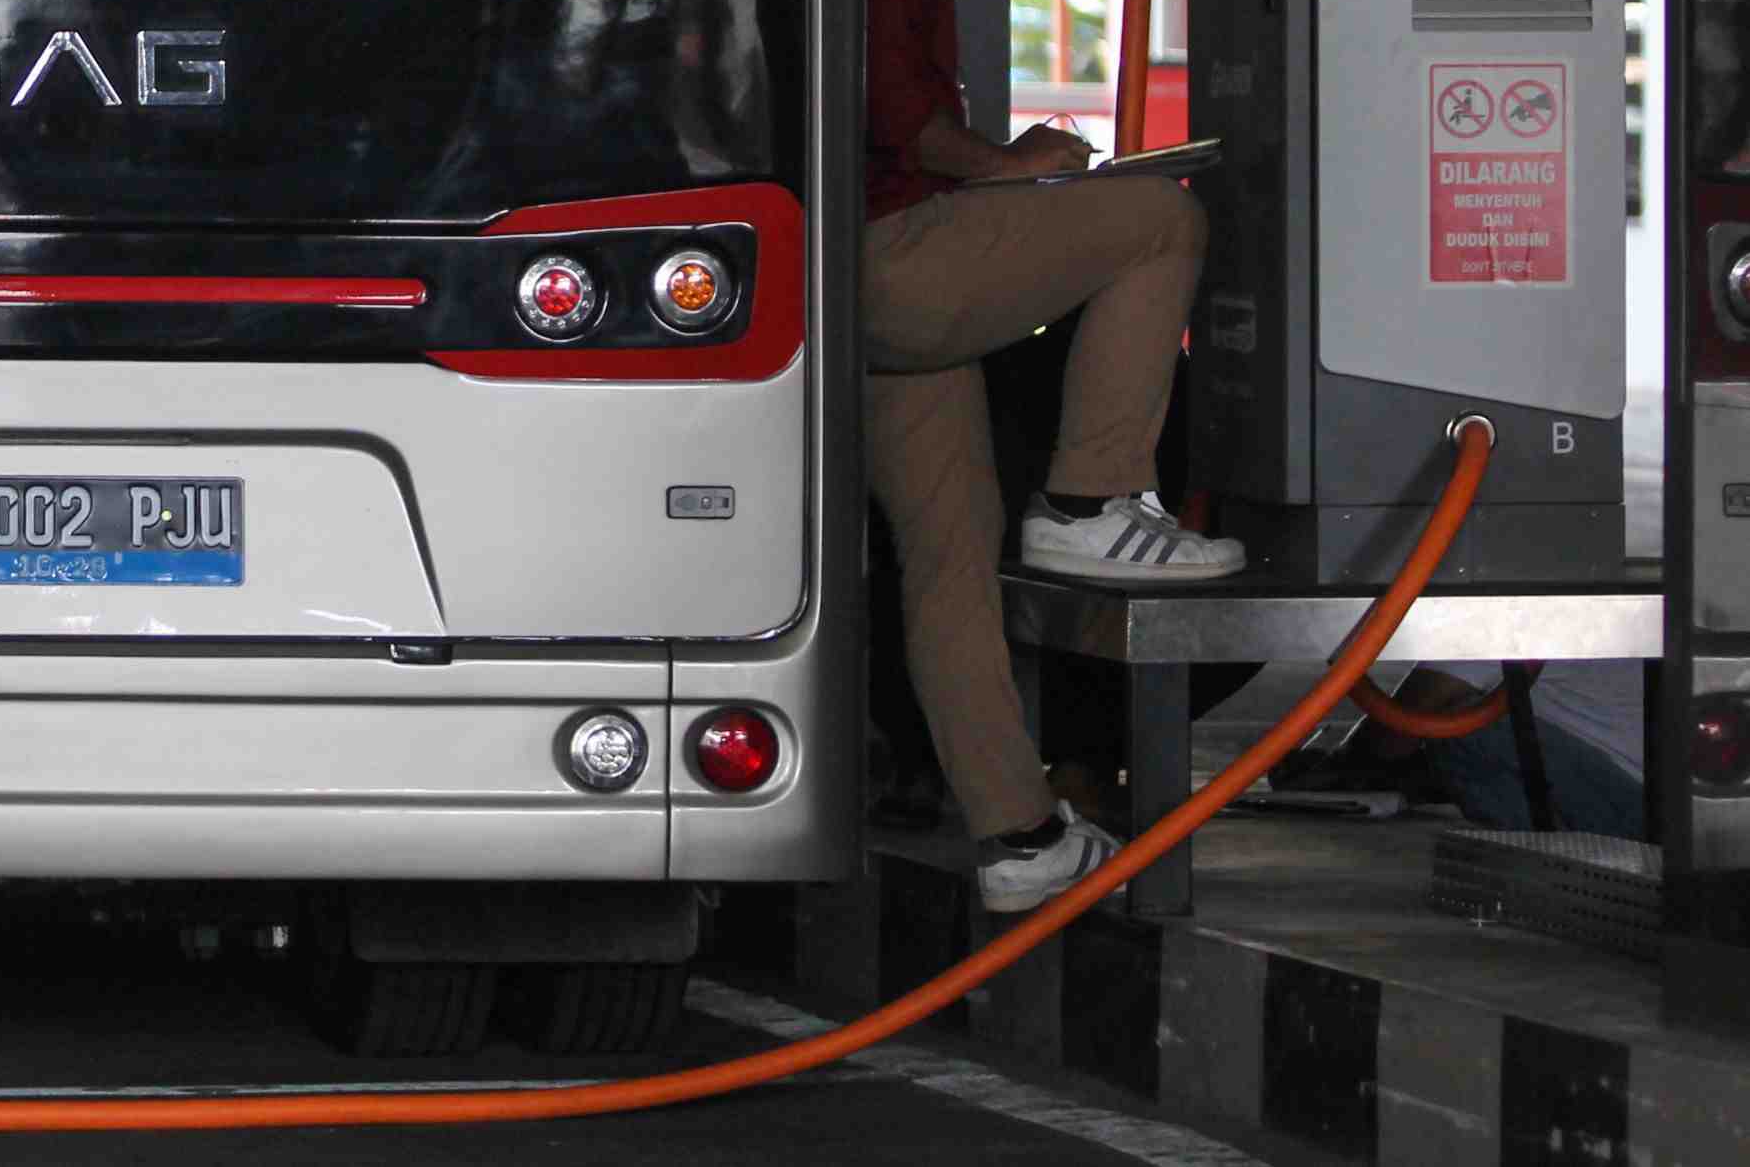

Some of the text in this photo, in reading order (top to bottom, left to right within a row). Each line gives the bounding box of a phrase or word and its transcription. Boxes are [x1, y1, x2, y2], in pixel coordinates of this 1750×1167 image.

[1439, 161, 1556, 185] DILARANG
[1453, 194, 1542, 209] MENYENTUH
[1482, 213, 1514, 227] DAN
[1445, 231, 1549, 247] DUDUK DISINI
[1552, 421, 1575, 455] B
[128, 485, 232, 548] PJU
